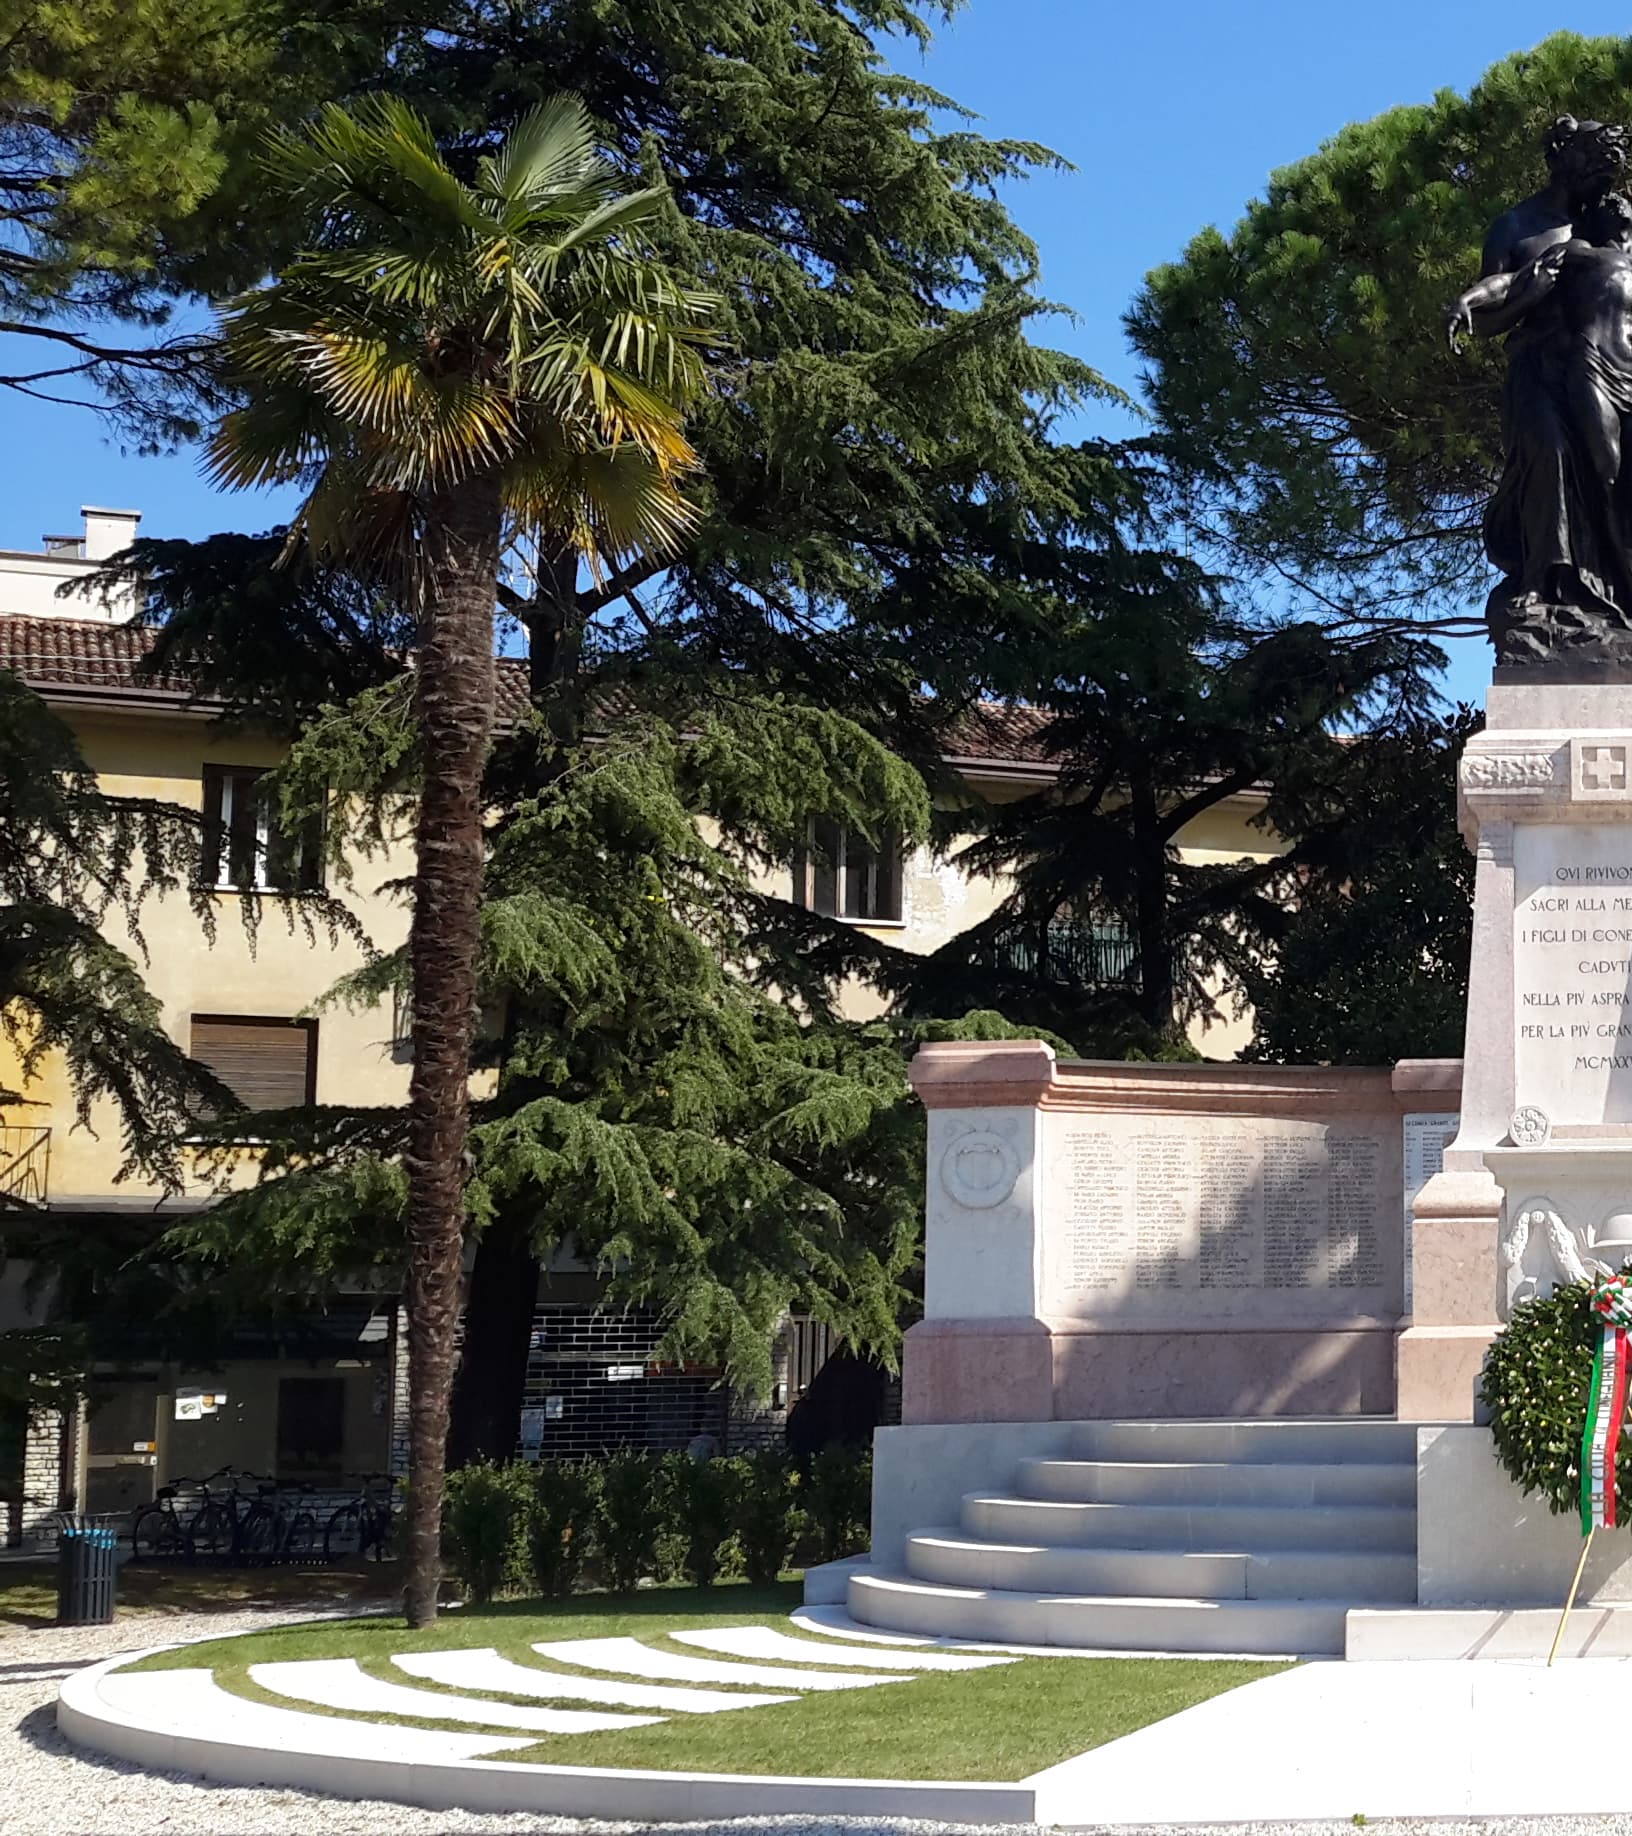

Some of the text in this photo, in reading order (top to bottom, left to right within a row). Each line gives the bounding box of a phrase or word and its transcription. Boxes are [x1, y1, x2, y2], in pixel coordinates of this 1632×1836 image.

[1555, 866, 1580, 881] QVI
[1529, 898, 1569, 912] SACRI
[1575, 898, 1606, 911] ALLA
[1531, 929, 1566, 943] FIGLI
[1571, 929, 1587, 942] DI
[1578, 960, 1632, 974] CADVTI
[1522, 992, 1561, 1006] NELLA
[1591, 992, 1630, 1006] ASPRA
[1521, 1024, 1544, 1039] PER
[1549, 1025, 1565, 1038] LA
